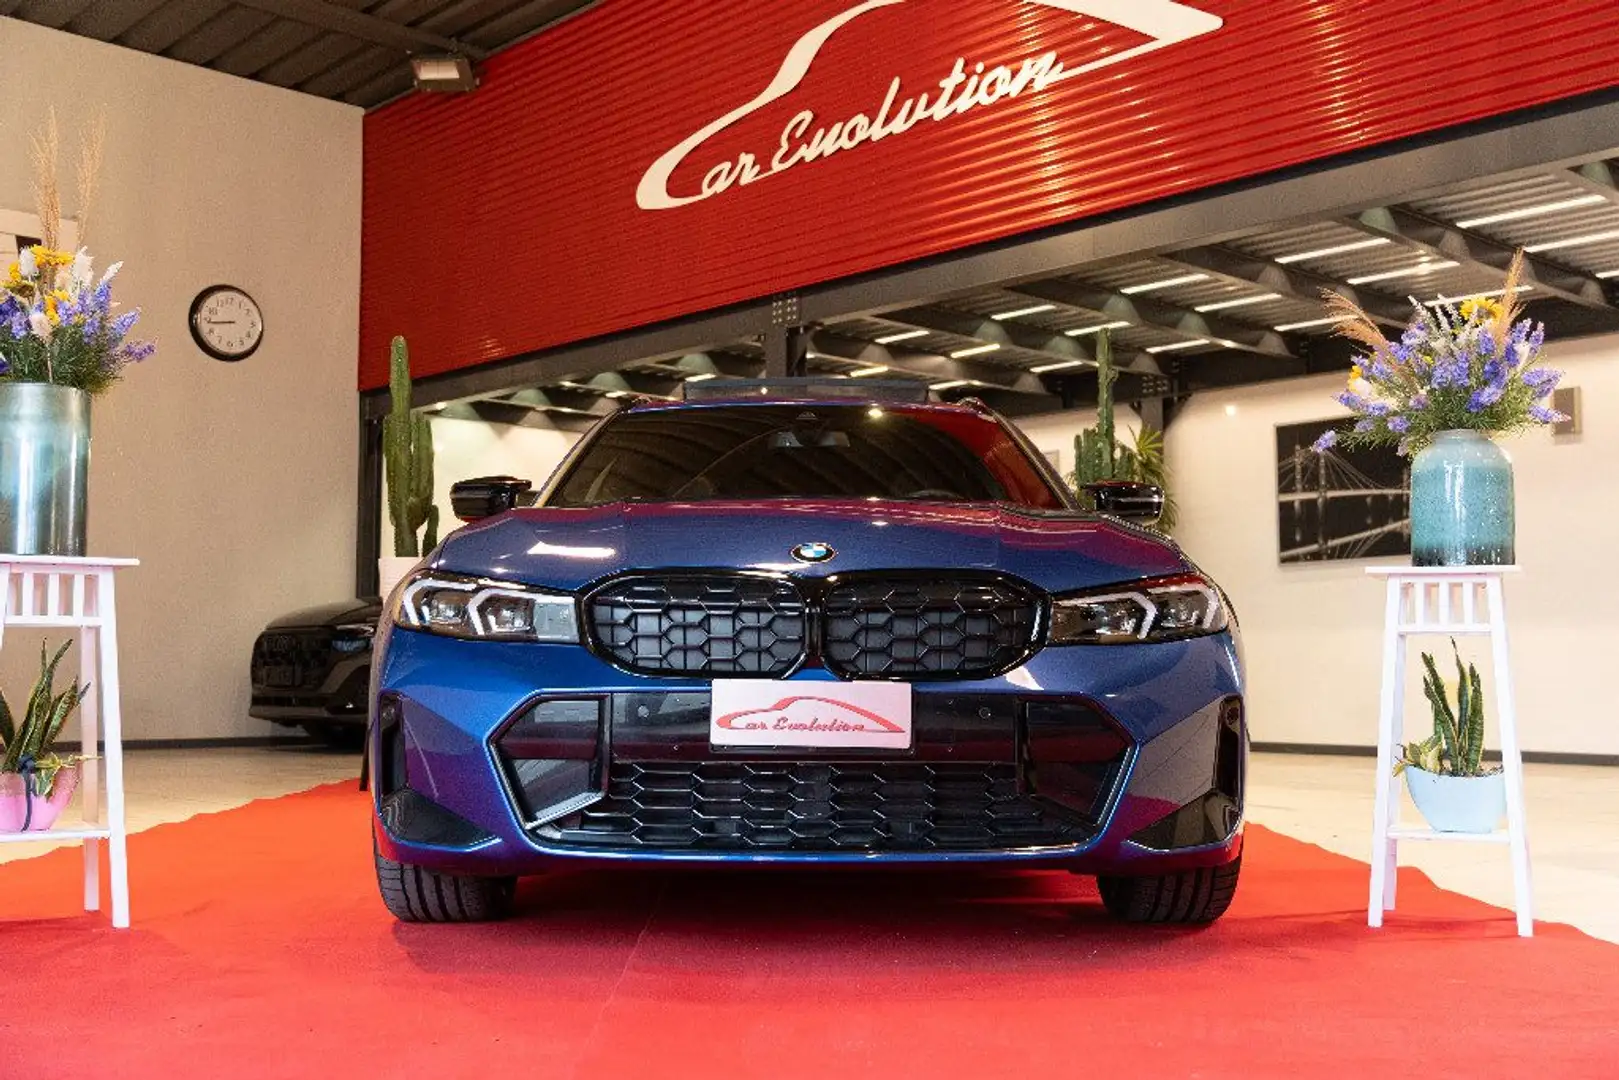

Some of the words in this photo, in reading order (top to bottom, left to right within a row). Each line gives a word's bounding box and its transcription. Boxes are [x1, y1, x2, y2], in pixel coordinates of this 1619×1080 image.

[636, 120, 760, 210] Car
[716, 711, 768, 731] Car
[773, 716, 865, 732] Evolution
